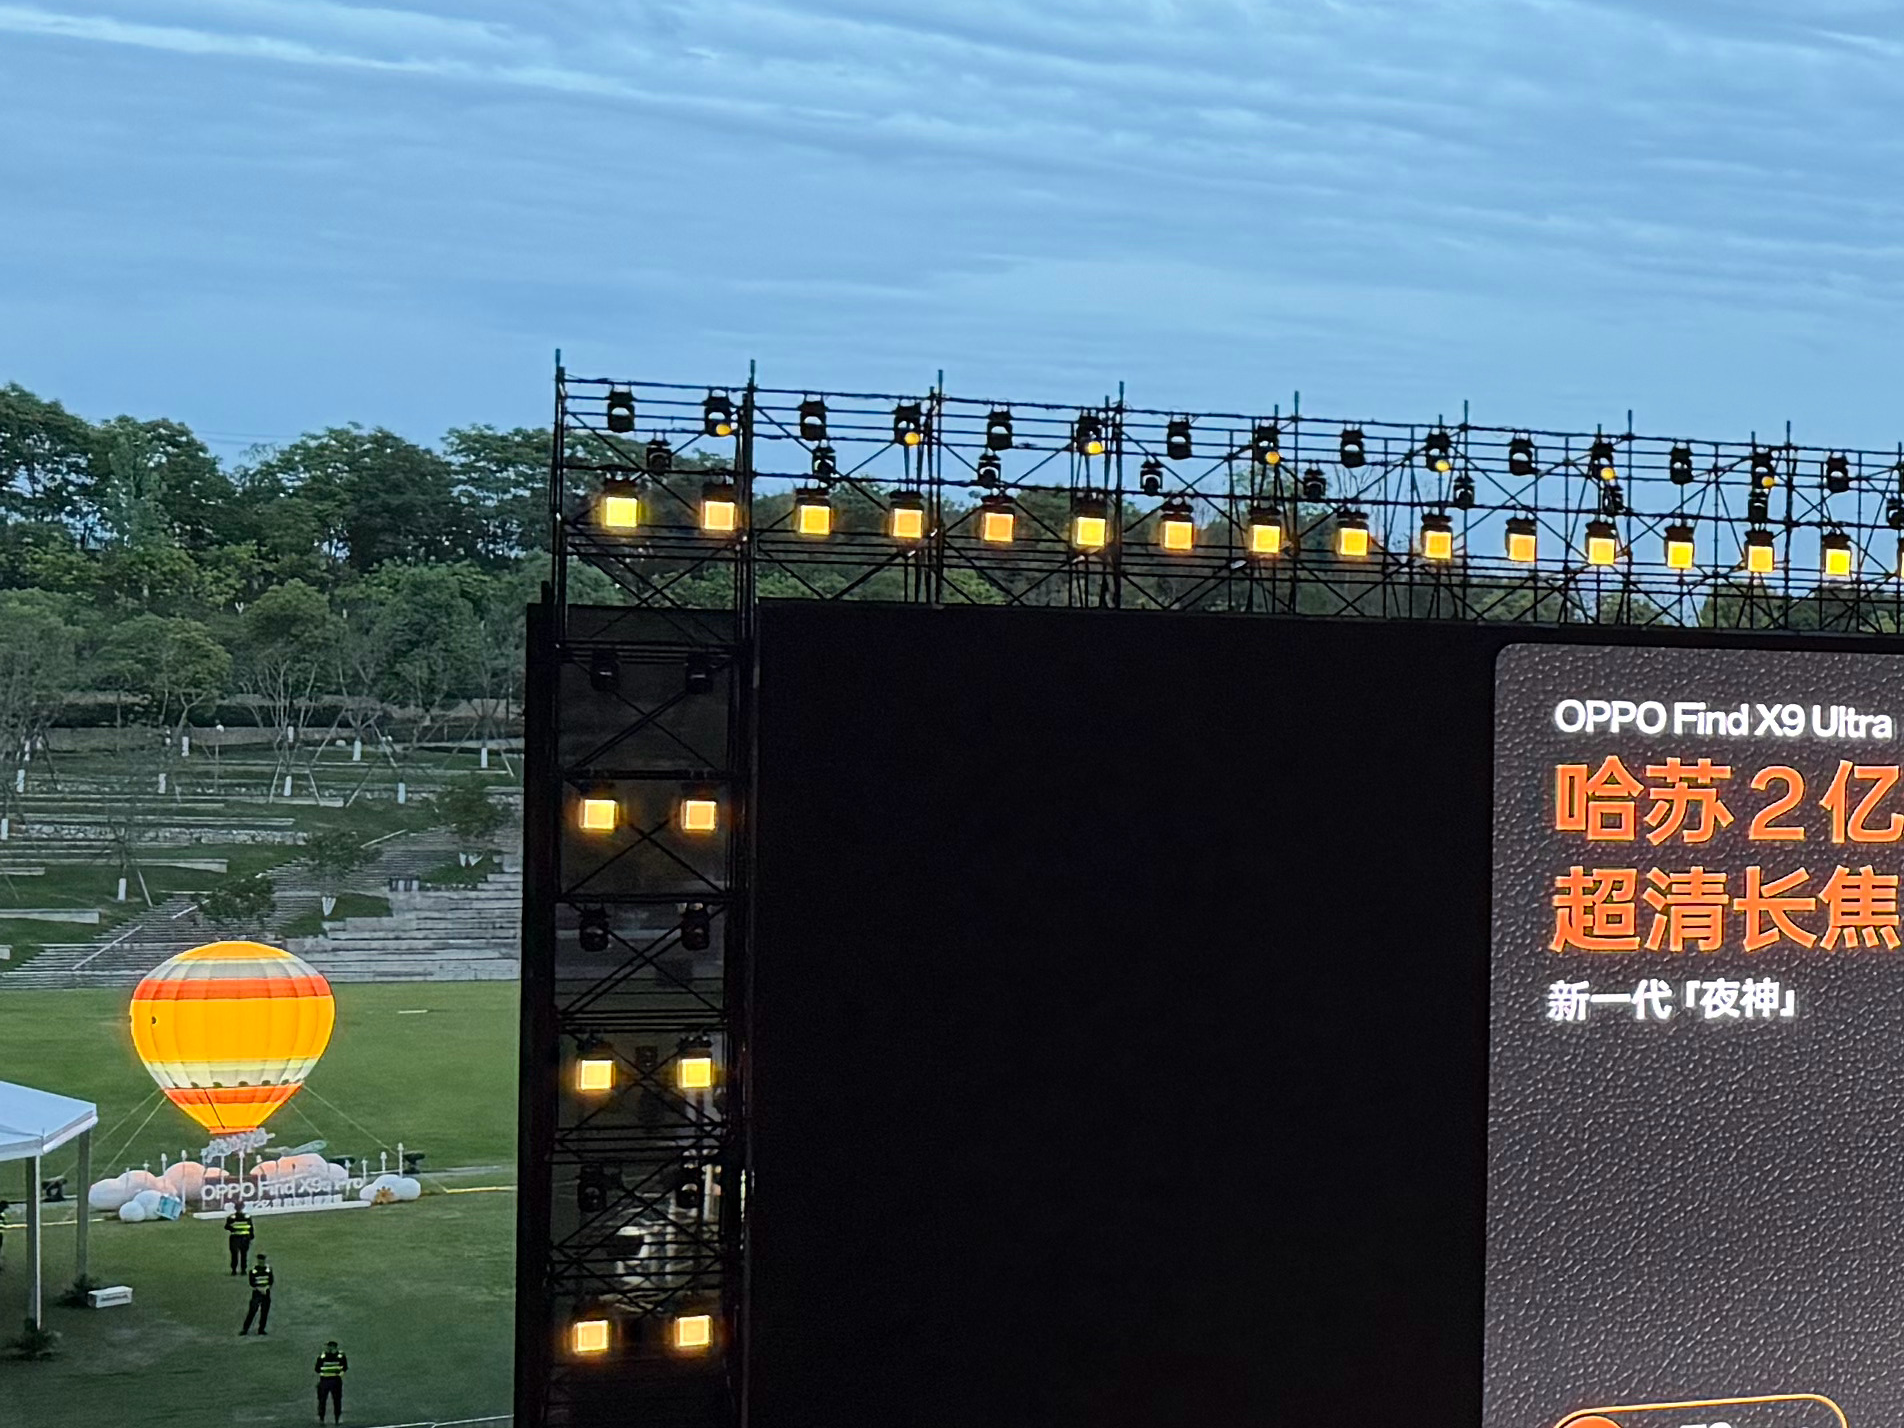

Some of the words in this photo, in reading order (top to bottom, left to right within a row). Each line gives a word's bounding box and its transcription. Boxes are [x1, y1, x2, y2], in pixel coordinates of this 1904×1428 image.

[1555, 699, 1667, 734] OPPO
[1674, 702, 1749, 736] Find
[1754, 704, 1806, 736] X9
[1812, 704, 1893, 739] Ultra
[1555, 755, 1732, 845] 哈苏
[1750, 765, 1806, 841] 2
[1548, 866, 1900, 953] 超清长焦
[202, 1182, 255, 1201] OPPO
